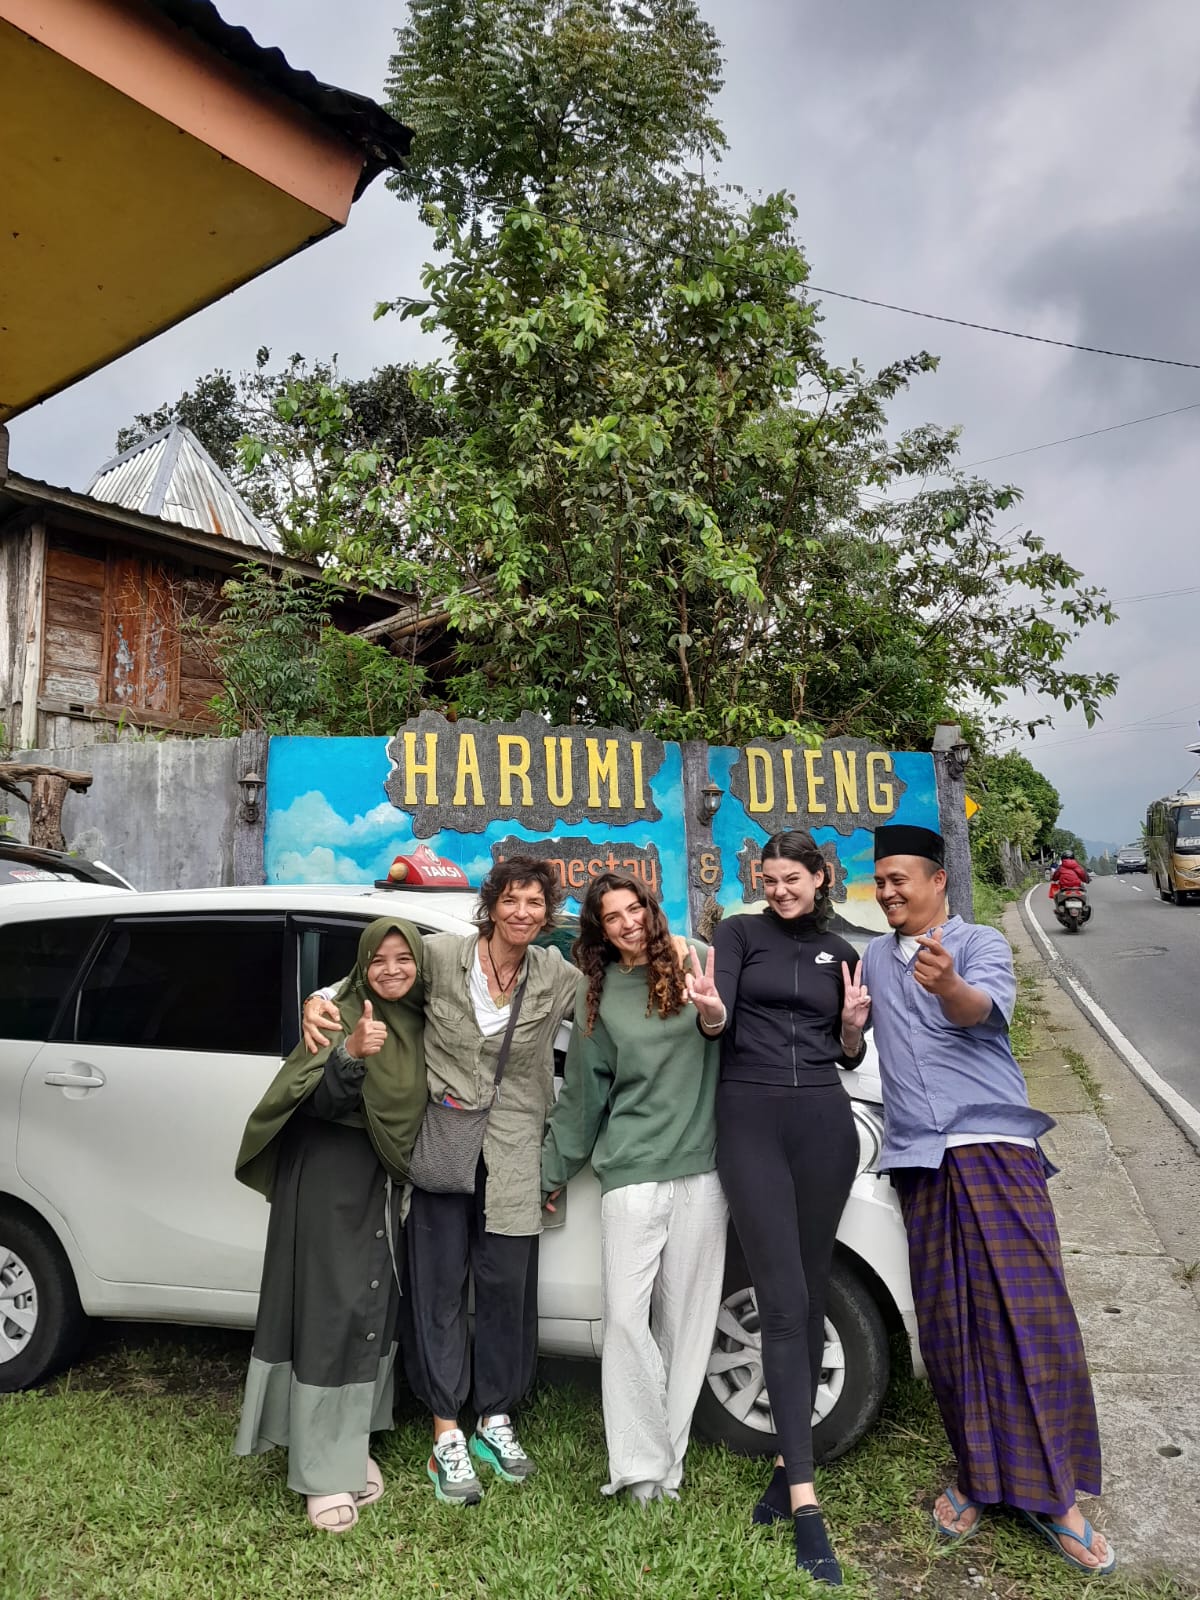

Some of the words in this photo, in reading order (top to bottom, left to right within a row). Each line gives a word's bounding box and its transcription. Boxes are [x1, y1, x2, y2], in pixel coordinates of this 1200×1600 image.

[403, 731, 647, 809] HARUMI
[745, 746, 894, 814] DIENG
[421, 865, 462, 878] TAKSI
[700, 852, 719, 885] &
